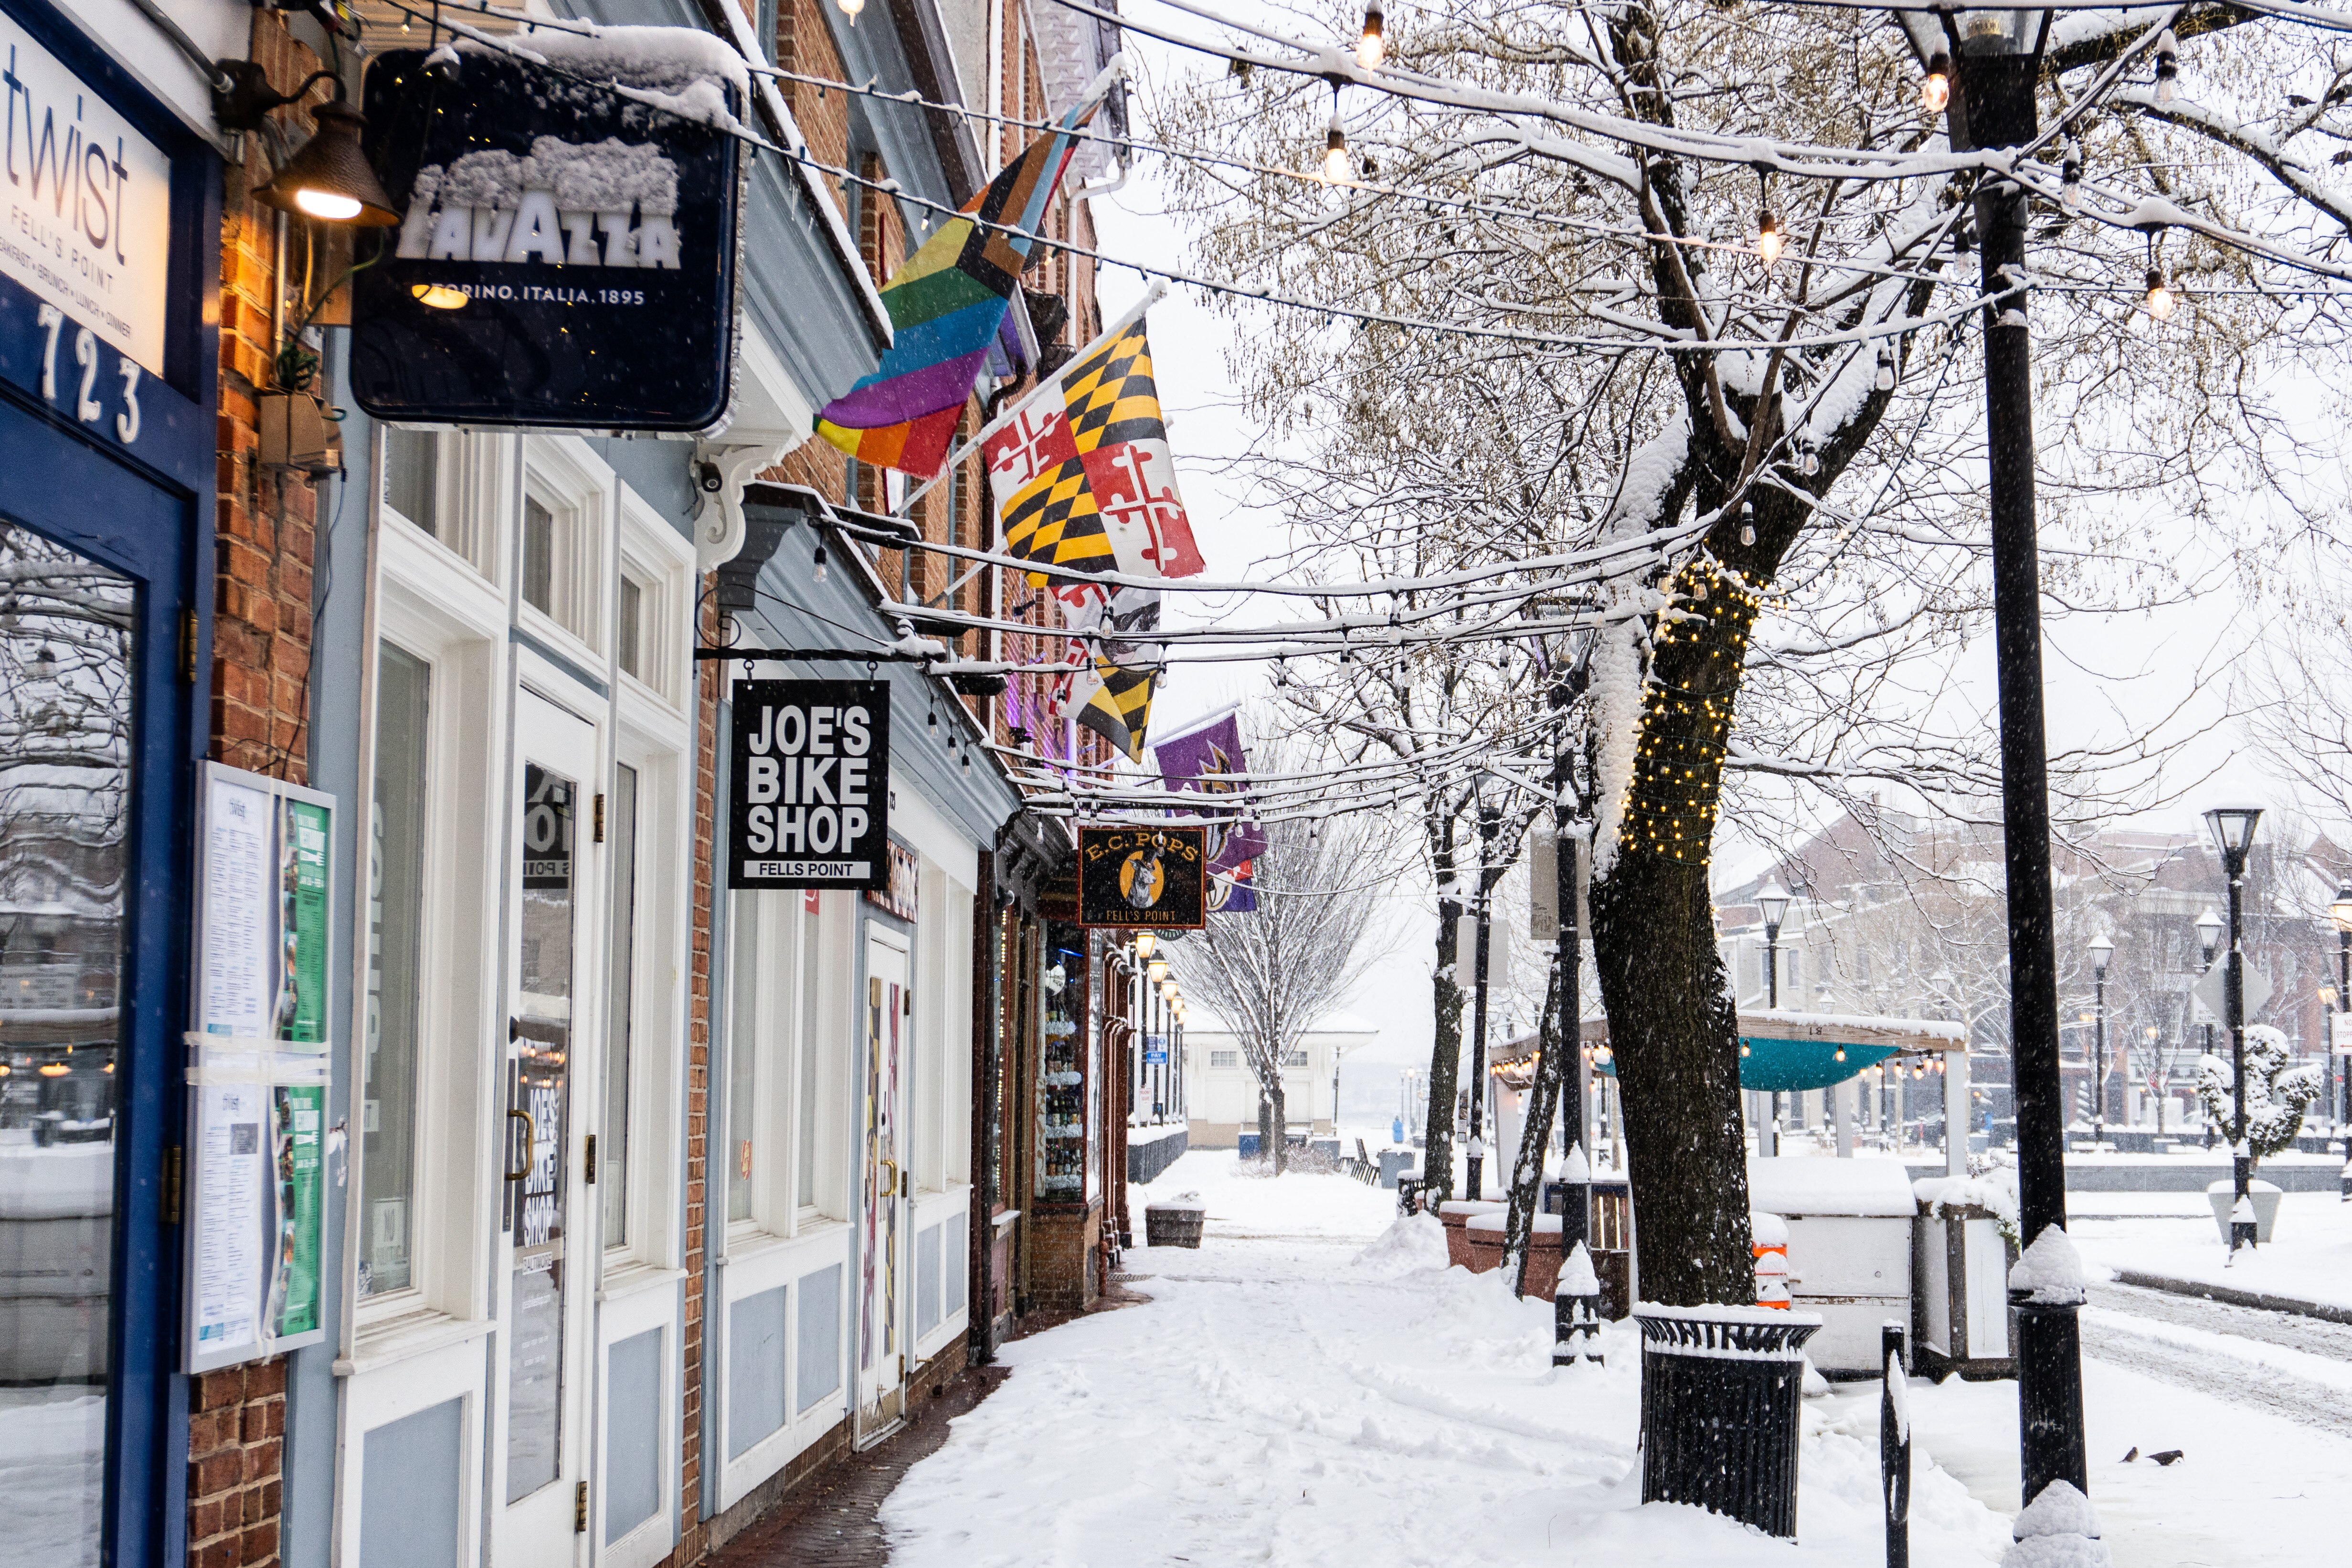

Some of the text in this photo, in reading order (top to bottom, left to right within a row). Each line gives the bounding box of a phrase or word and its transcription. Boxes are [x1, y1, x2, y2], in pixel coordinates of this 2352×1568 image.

[2, 43, 128, 266] twist
[11, 203, 113, 295] FELL'S POINT
[38, 264, 68, 297] BRUNCH
[75, 291, 100, 319] LUNCH
[106, 311, 131, 340] DINNER
[599, 289, 645, 306] 1895
[748, 705, 870, 756] JOE'S
[748, 757, 869, 805] BIKE
[747, 805, 869, 854] SHOP
[1085, 833, 1198, 862] E.C. POPS
[759, 863, 853, 877] FELLS POINT
[1106, 910, 1176, 922] FELL'S POINT
[524, 1195, 552, 1248] SHOP
